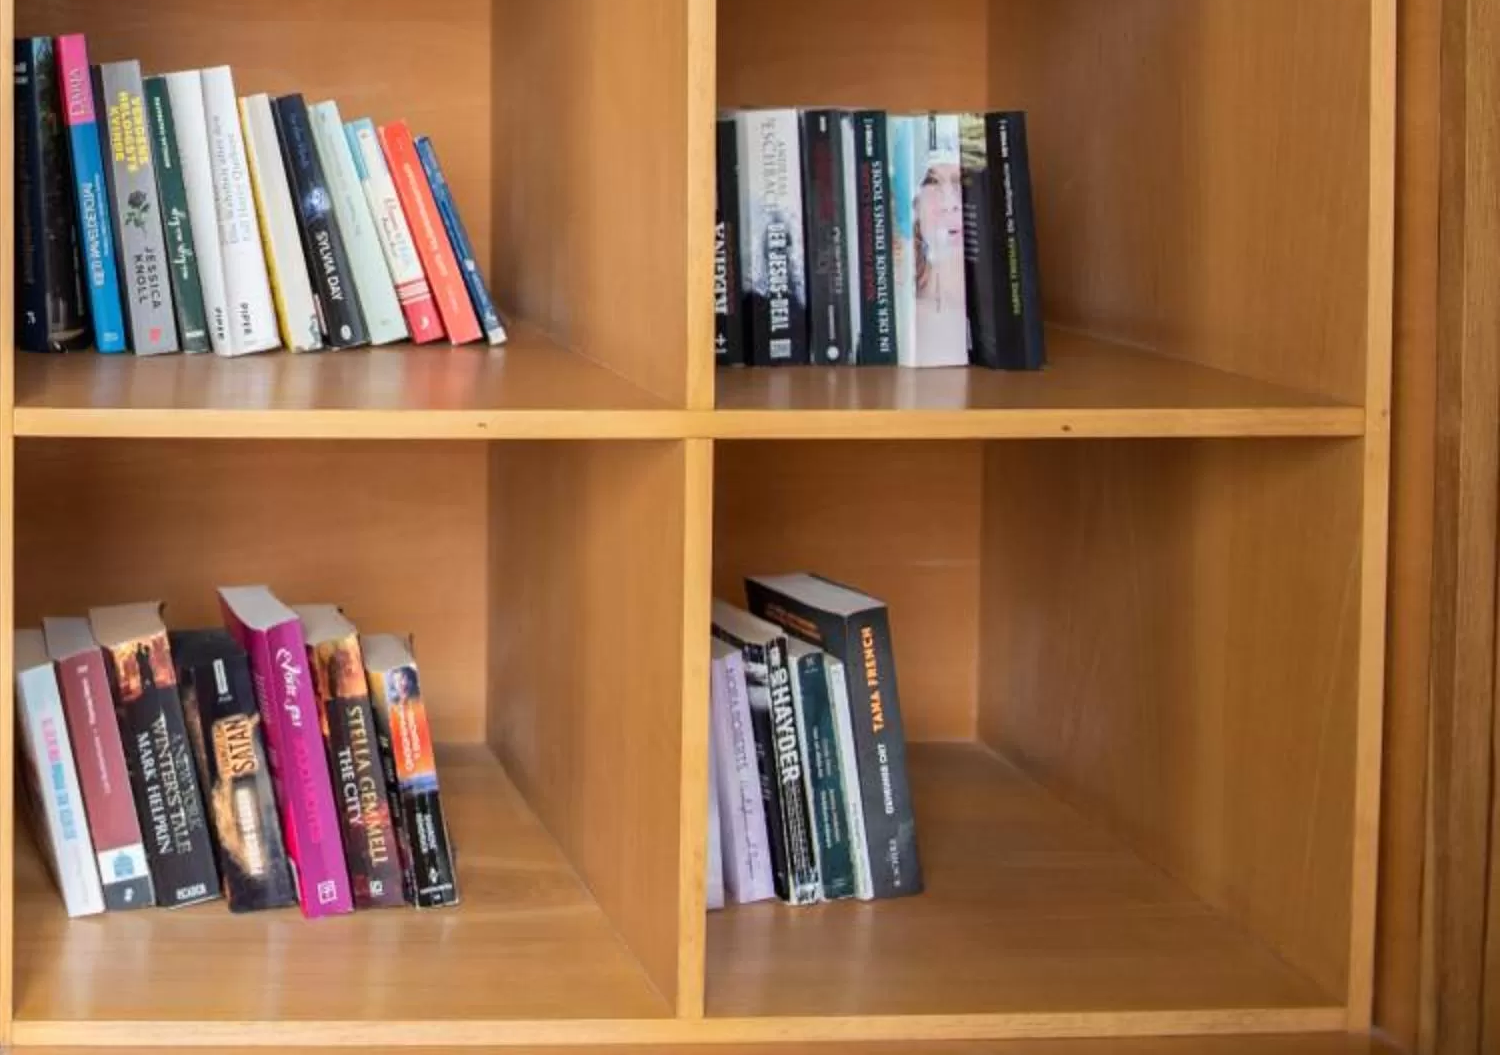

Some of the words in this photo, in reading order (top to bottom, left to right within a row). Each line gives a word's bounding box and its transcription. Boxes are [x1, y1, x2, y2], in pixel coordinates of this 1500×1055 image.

[871, 160, 884, 202] TODES
[767, 222, 786, 249] DER
[873, 203, 886, 250] DEINES
[133, 254, 148, 305] KNOLL
[144, 246, 162, 310] JESSICA
[315, 229, 337, 274] SYLVIA
[326, 276, 344, 301] DAY
[875, 254, 889, 306] STUNDE
[768, 251, 789, 332] JESUS-DEAL
[213, 306, 225, 341] PIPER
[239, 302, 254, 336] PIPER
[877, 306, 890, 334] DER
[878, 336, 892, 353] IN
[859, 626, 879, 687] FRENCH
[770, 685, 801, 786] HAYDER
[868, 690, 885, 733] TANA
[174, 744, 192, 782] NEW
[224, 718, 257, 775] SATAN
[337, 745, 356, 781] THE
[134, 730, 155, 781] MARK
[145, 784, 174, 854] HELPRIN
[149, 711, 181, 807] WINTER'S
[170, 808, 193, 853] TALE
[343, 781, 364, 827] CITY
[345, 703, 372, 771] STELLA
[359, 775, 389, 867] GEMMELL
